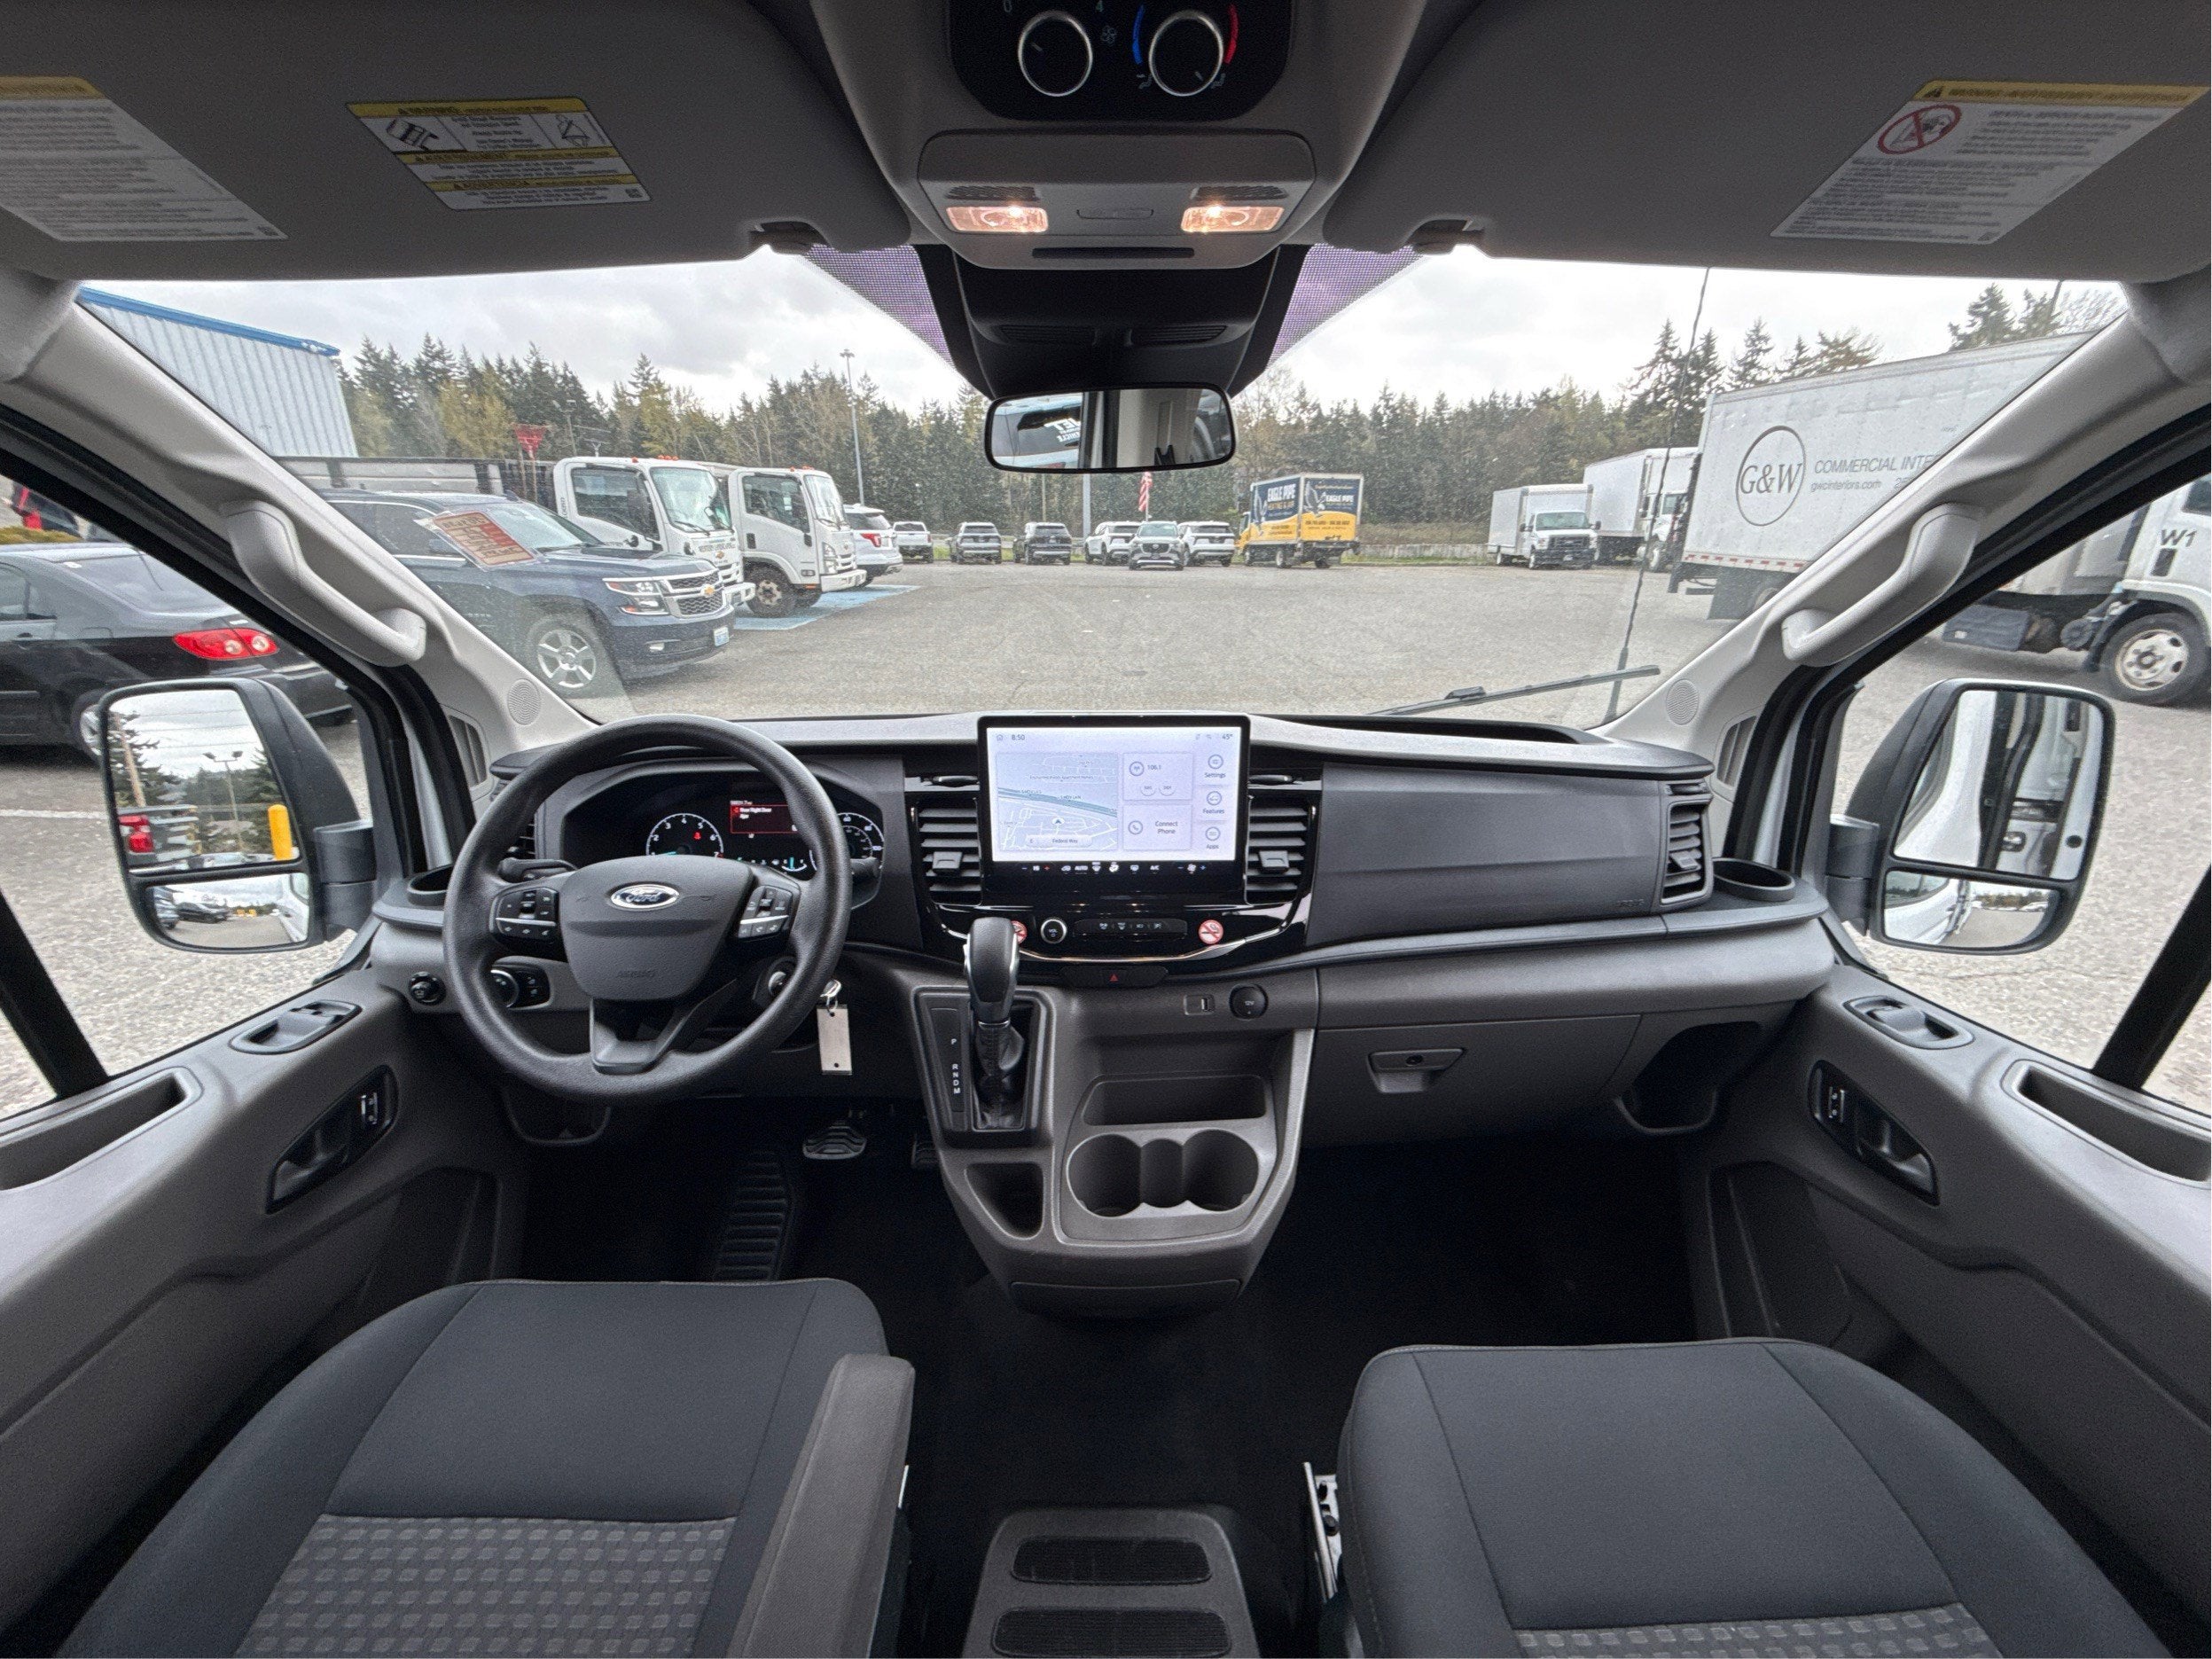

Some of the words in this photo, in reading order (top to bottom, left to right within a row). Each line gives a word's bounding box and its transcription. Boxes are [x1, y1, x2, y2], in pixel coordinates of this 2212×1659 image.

[1814, 457, 1897, 474] COMMERCIAL
[1902, 454, 1940, 470] INTE
[1740, 462, 1803, 494] G&W
[1267, 486, 1283, 502] EAGLE
[1283, 483, 1296, 500] PIPE
[2161, 528, 2197, 546] W1
